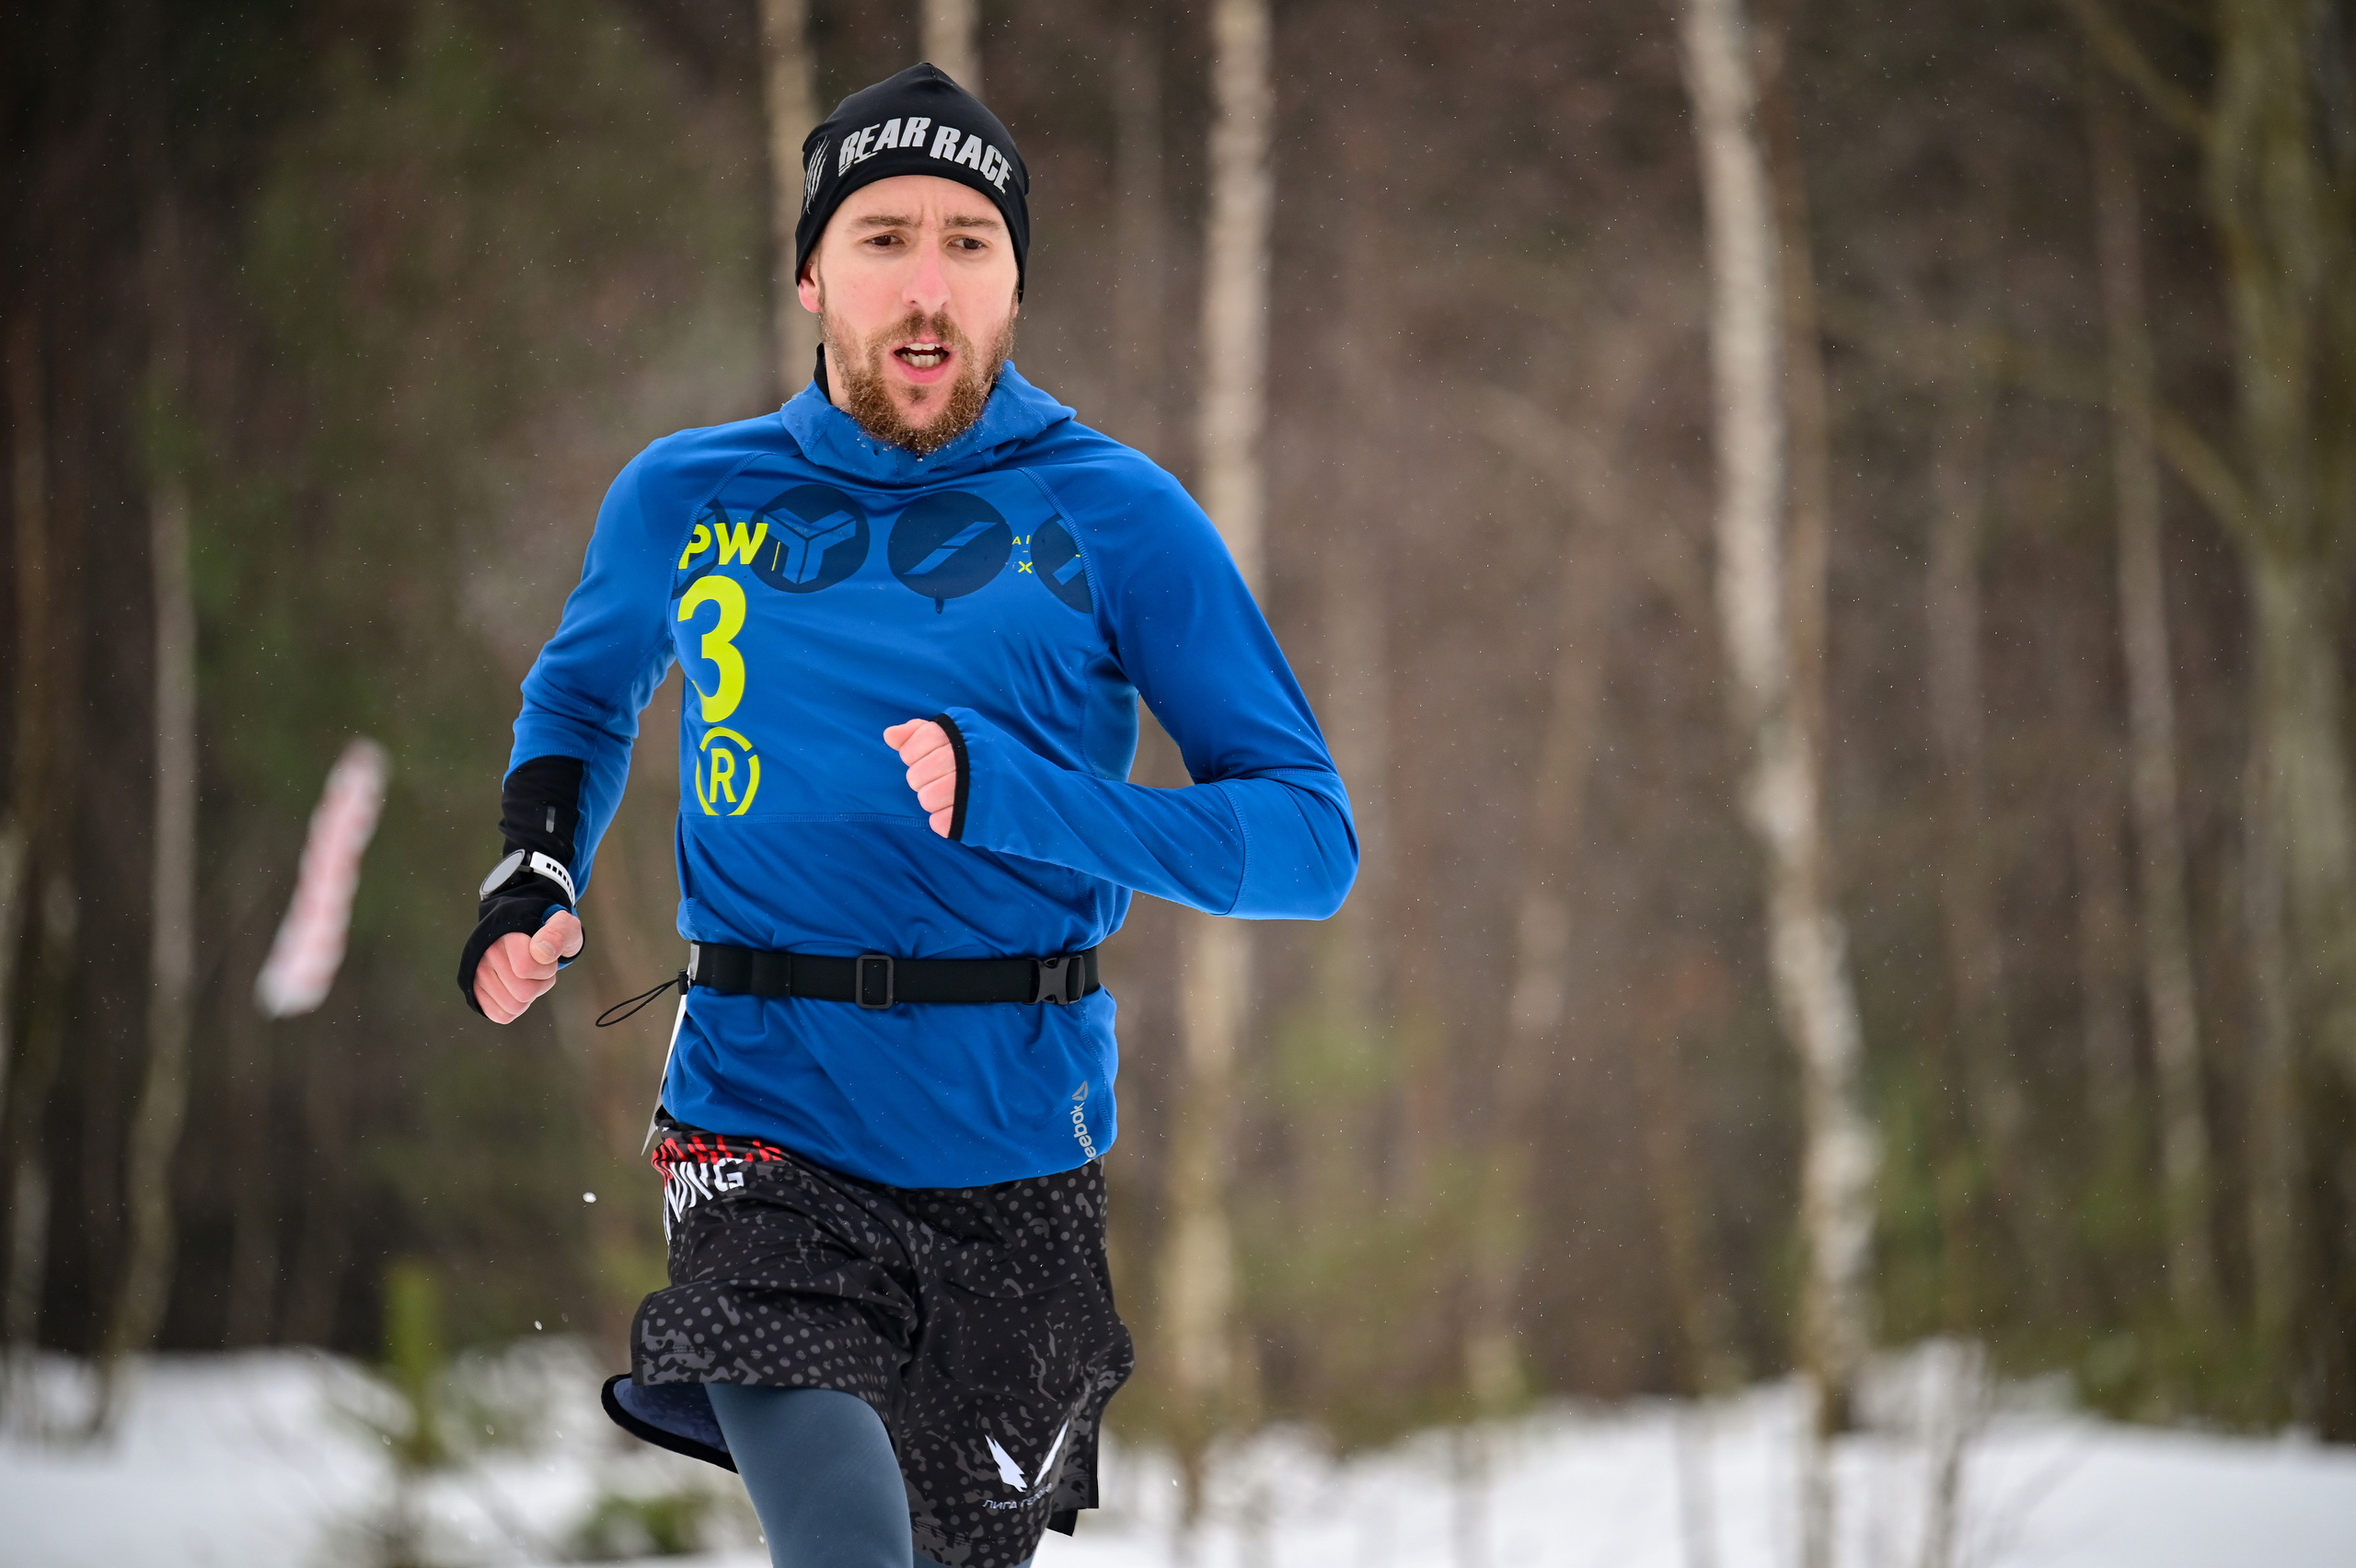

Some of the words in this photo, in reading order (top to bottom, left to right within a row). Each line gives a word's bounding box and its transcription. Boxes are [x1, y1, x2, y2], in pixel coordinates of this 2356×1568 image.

[929, 125, 1012, 194] RACE
[676, 575, 746, 723] 3
[1069, 1101, 1098, 1164] eebok
[982, 1499, 1018, 1510] ЛИГА
